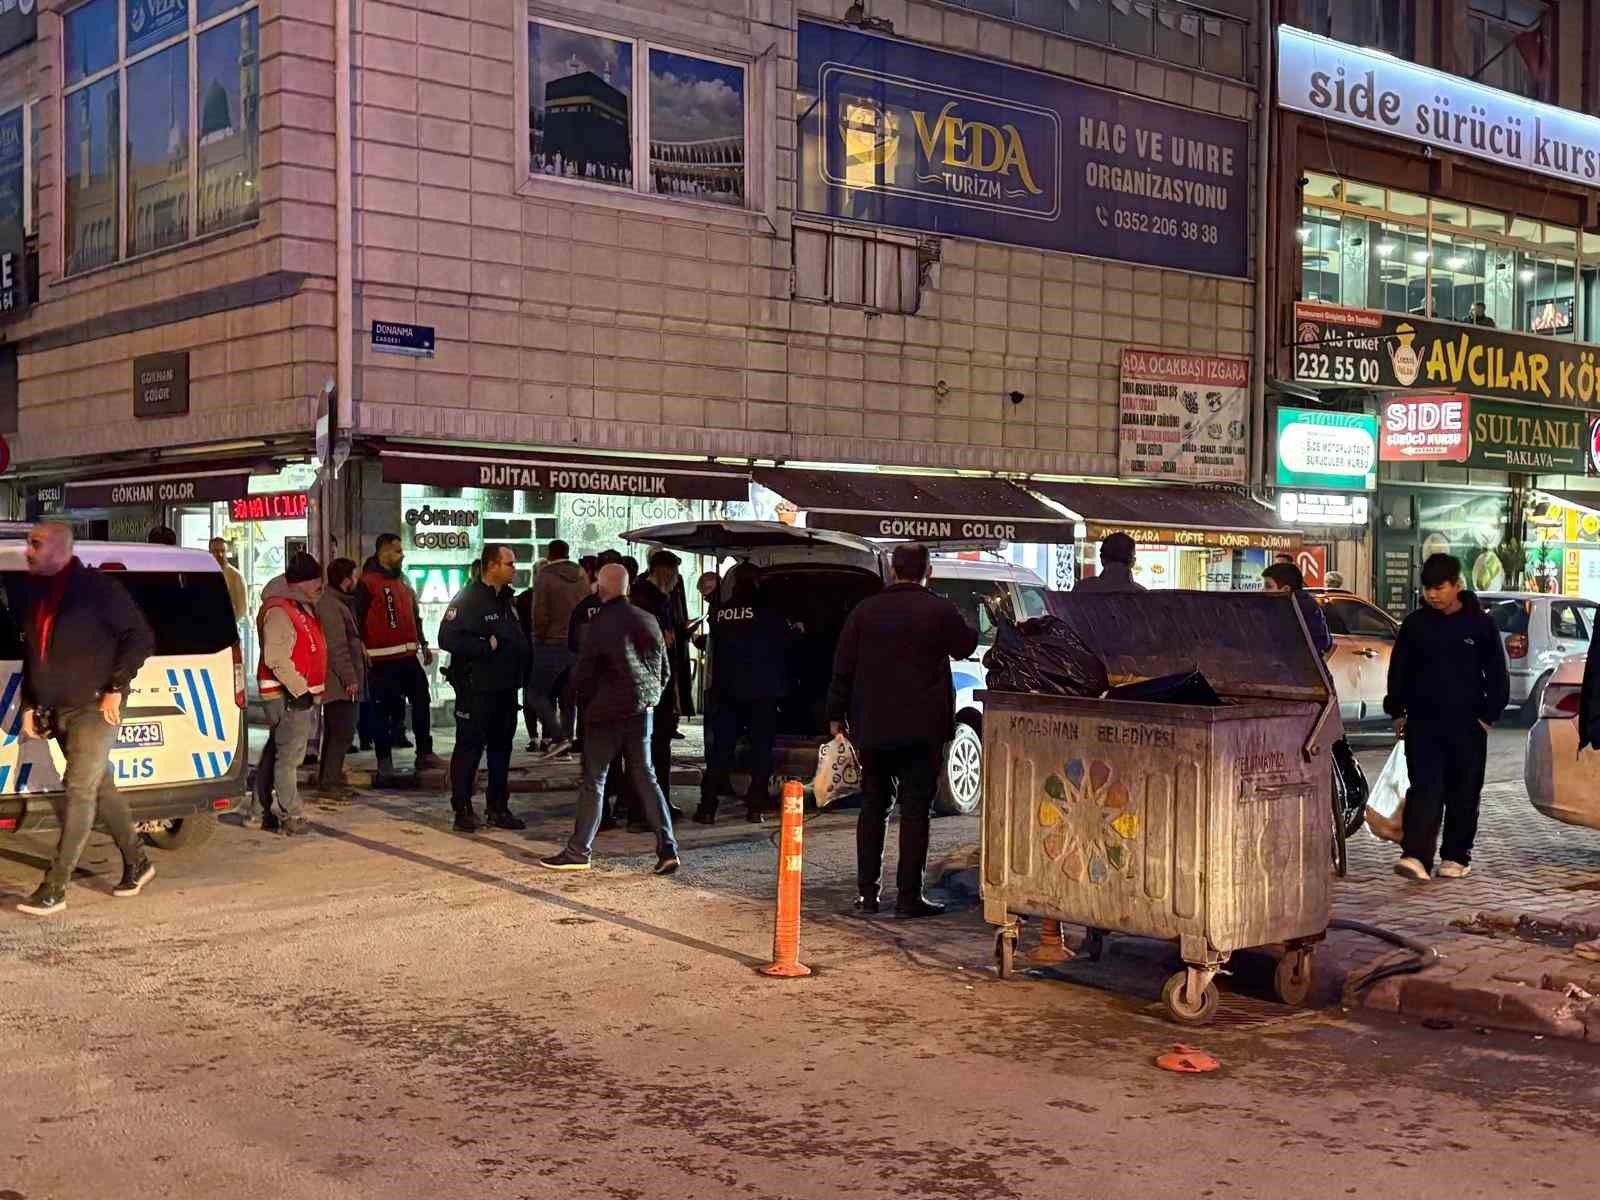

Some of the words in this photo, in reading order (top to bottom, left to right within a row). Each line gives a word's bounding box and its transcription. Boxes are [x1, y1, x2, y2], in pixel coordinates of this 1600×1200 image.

[1308, 66, 1401, 126] side
[1416, 95, 1522, 161] sürücü
[1533, 114, 1600, 178] kurs
[911, 101, 1043, 194] VEDA
[1079, 117, 1127, 152] HAC
[1135, 127, 1164, 164] VE
[1172, 135, 1234, 177] UMRE
[941, 171, 1002, 199] TURİZM
[1085, 160, 1228, 211] ORGANİZASYONU
[1114, 208, 1149, 232] 0352
[1152, 213, 1178, 236] 206
[1182, 220, 1199, 241] 38
[1201, 223, 1219, 244] 38
[376, 323, 414, 337] DONANMA
[1297, 351, 1330, 379] 232
[1334, 356, 1355, 381] 55
[1359, 358, 1380, 384] 00
[1426, 332, 1552, 399] AVCILAR
[1475, 412, 1580, 450] SULTANLI
[1505, 450, 1553, 467] BAKLAVA
[480, 465, 540, 487] DİJİTAL
[112, 485, 154, 503] GÖKHAN
[159, 483, 195, 501] COLOR
[879, 516, 951, 538] GÖKHAN
[962, 519, 1017, 540] COLOR
[1123, 529, 1160, 542] ZGARA
[1174, 530, 1204, 545] KÖFTE
[1219, 532, 1250, 547] DÖNER
[117, 724, 160, 744] 48239
